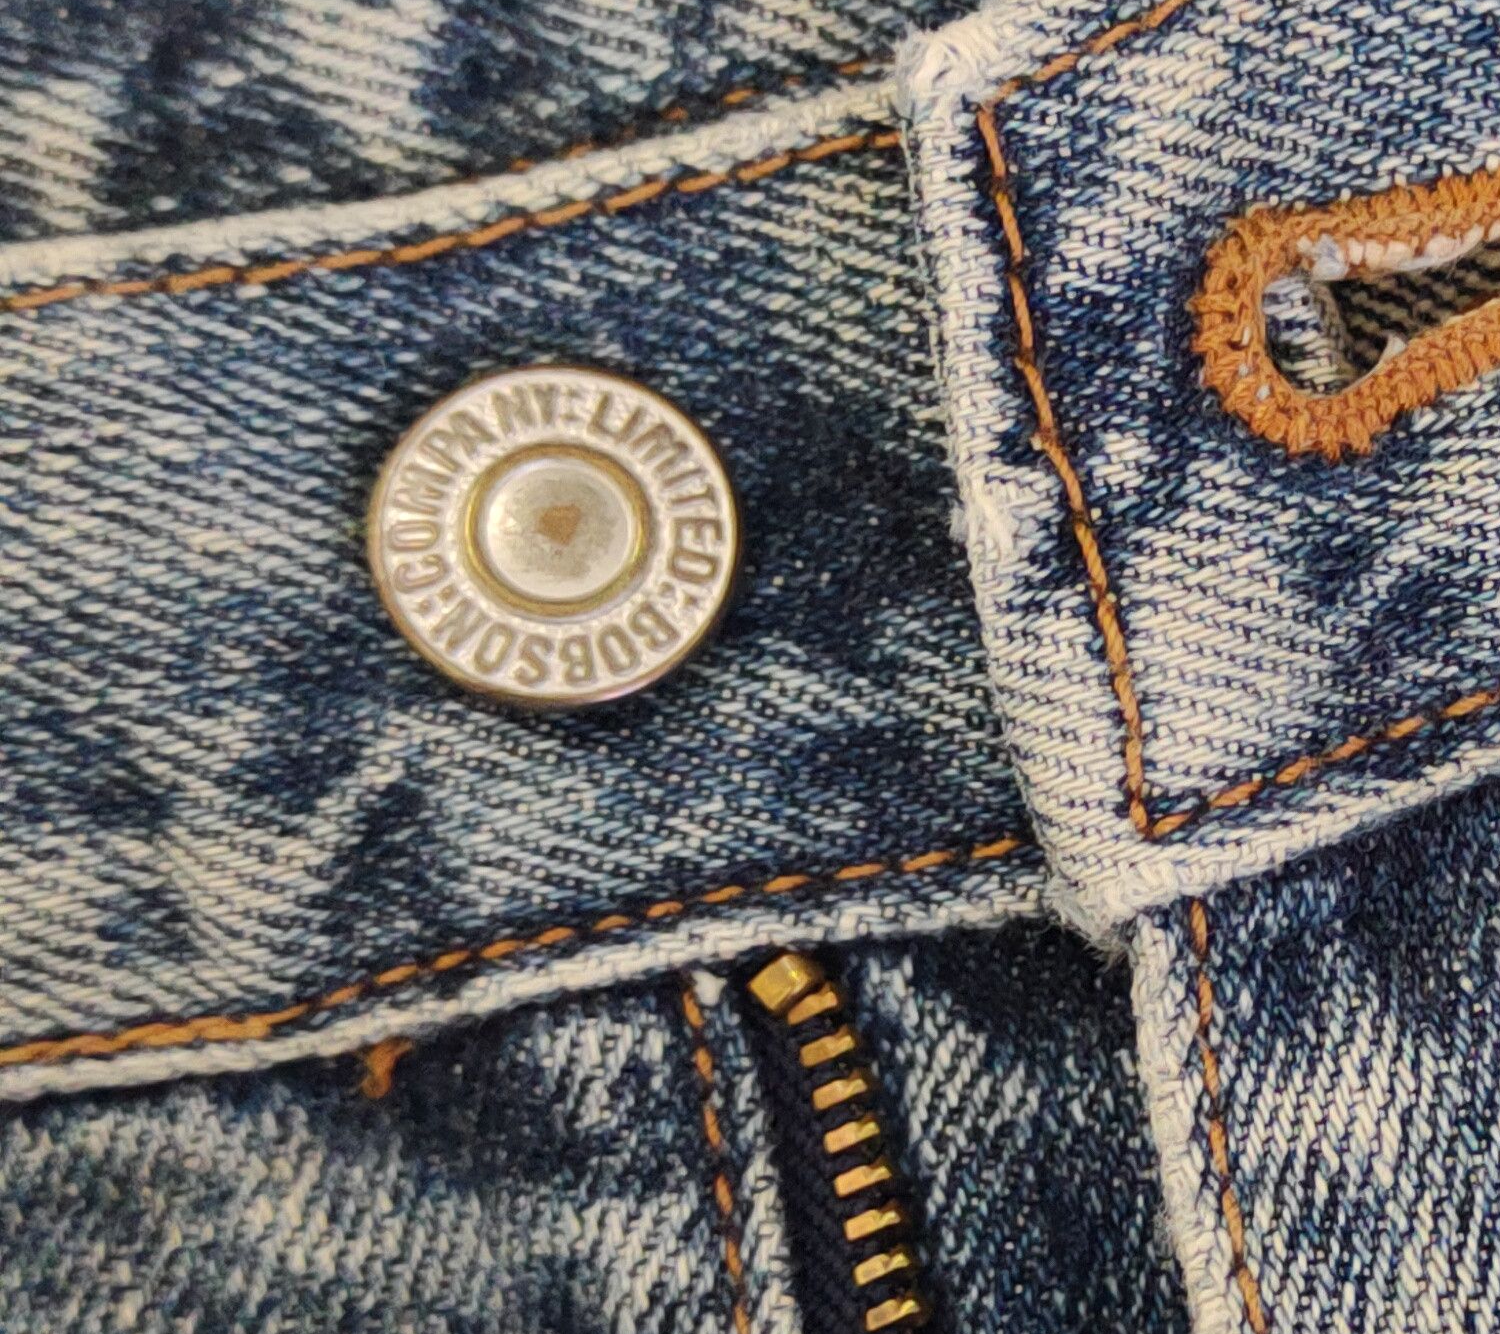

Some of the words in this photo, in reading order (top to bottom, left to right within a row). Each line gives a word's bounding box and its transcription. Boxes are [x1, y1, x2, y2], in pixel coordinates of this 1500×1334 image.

[386, 382, 557, 593] COMPANY
[587, 393, 724, 585] LIMITED
[429, 596, 682, 686] BOBSON
